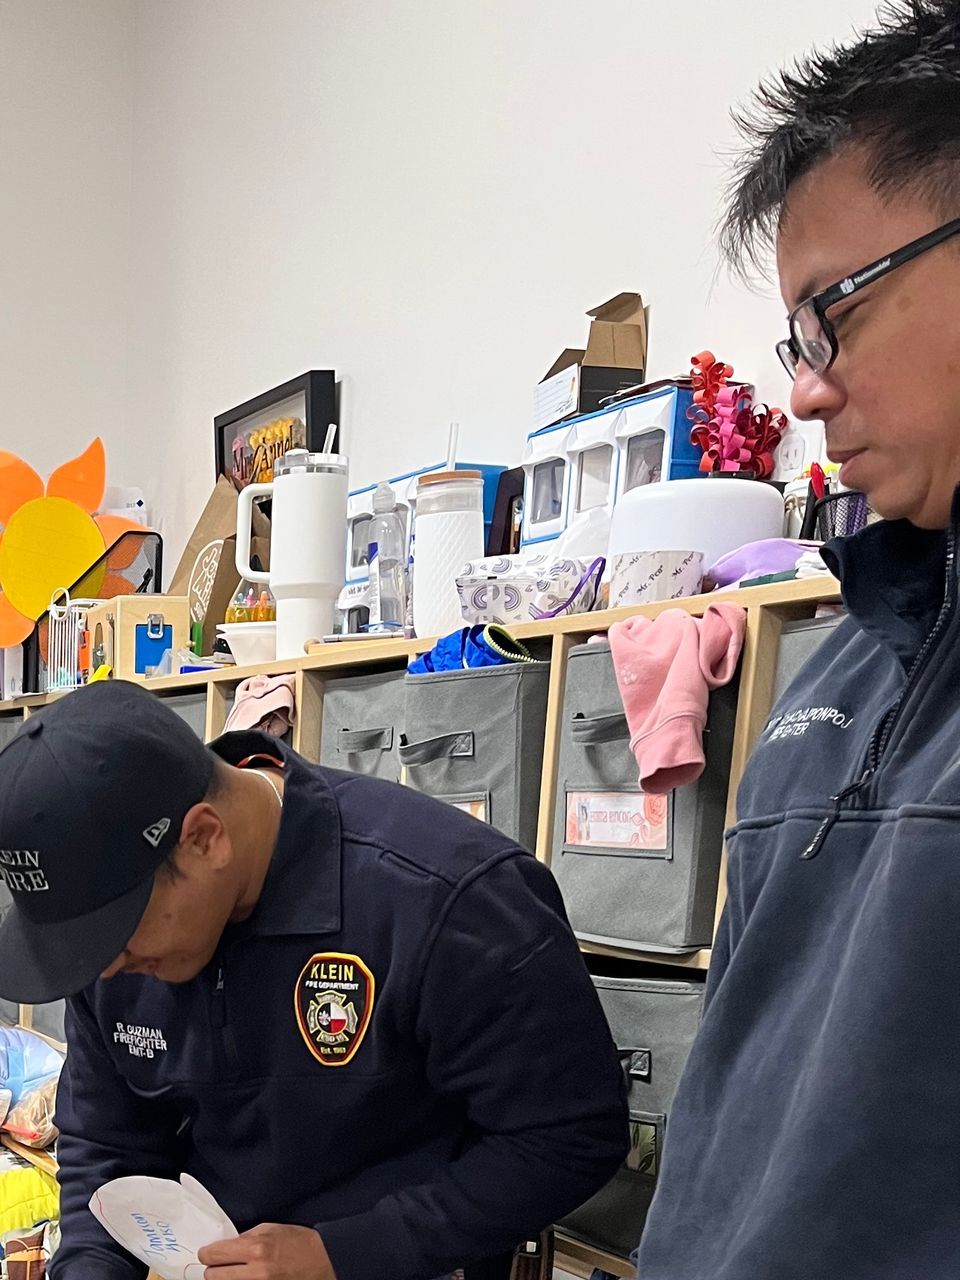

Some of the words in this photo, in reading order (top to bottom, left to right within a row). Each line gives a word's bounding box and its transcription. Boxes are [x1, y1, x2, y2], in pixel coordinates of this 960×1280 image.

[310, 963, 354, 981] KLEIN
[305, 980, 318, 989] FIRE
[318, 981, 360, 991] DEPARTMENT
[126, 1024, 163, 1040] GUZMAN
[113, 1031, 168, 1051] FIREFIGHTER
[128, 1044, 155, 1059] EMT-B
